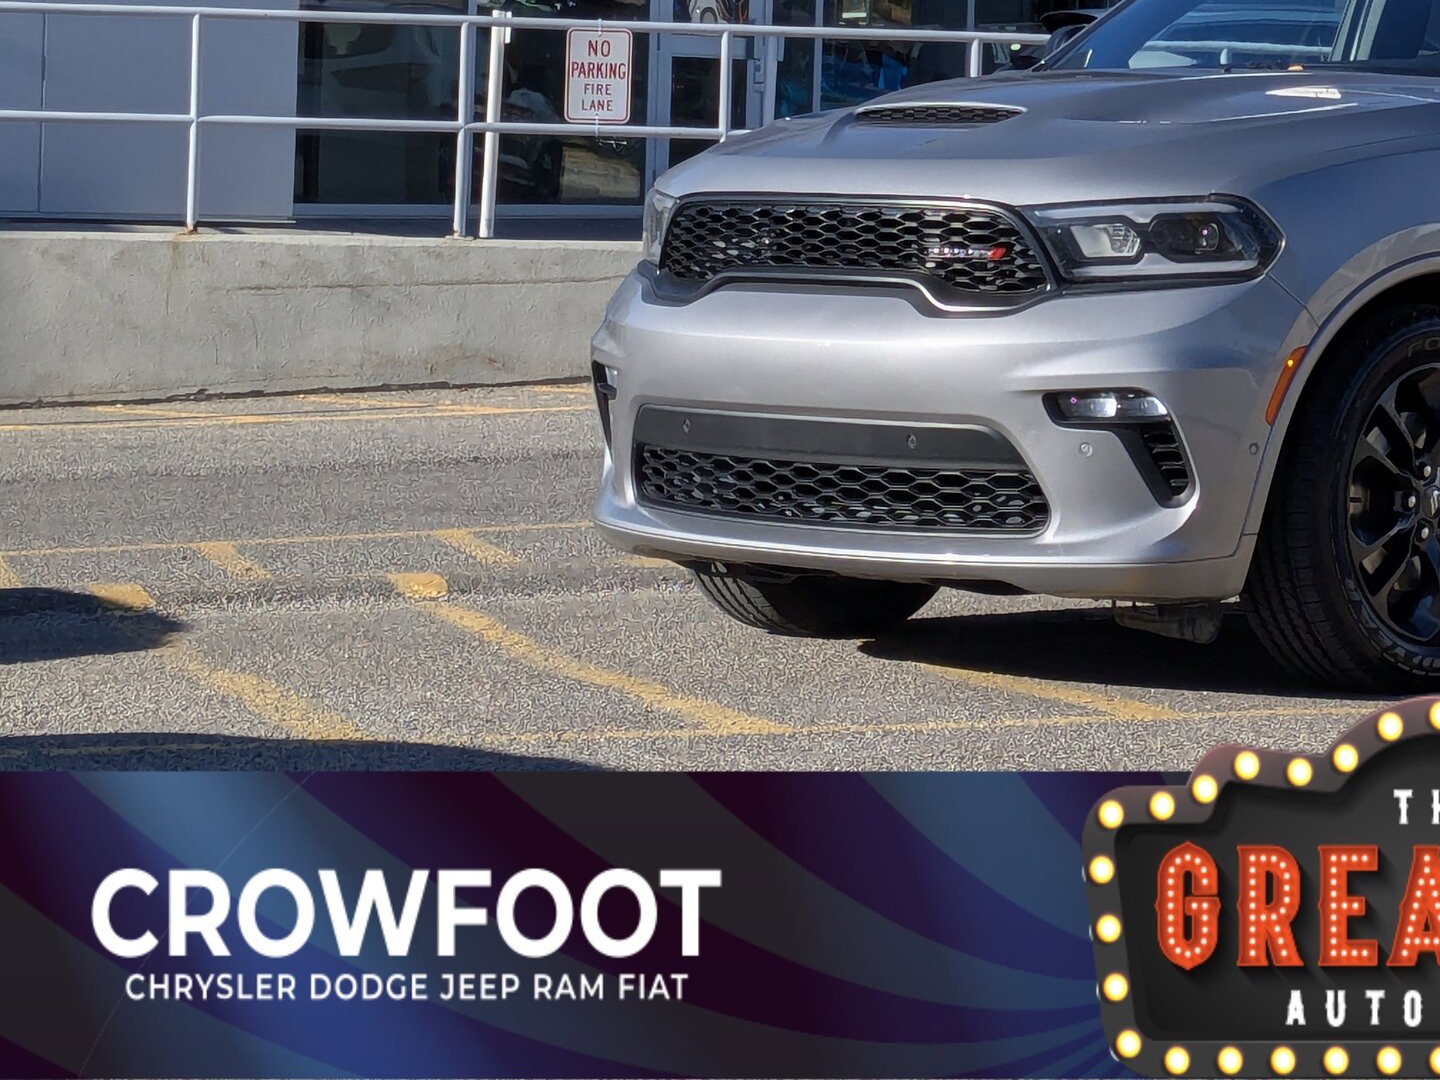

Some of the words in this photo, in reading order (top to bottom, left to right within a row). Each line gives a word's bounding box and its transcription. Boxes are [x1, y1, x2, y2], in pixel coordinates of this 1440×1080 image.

[588, 39, 611, 57] NO
[571, 61, 627, 80] PARKING
[584, 83, 612, 96] FIRE
[581, 99, 613, 112] LANE
